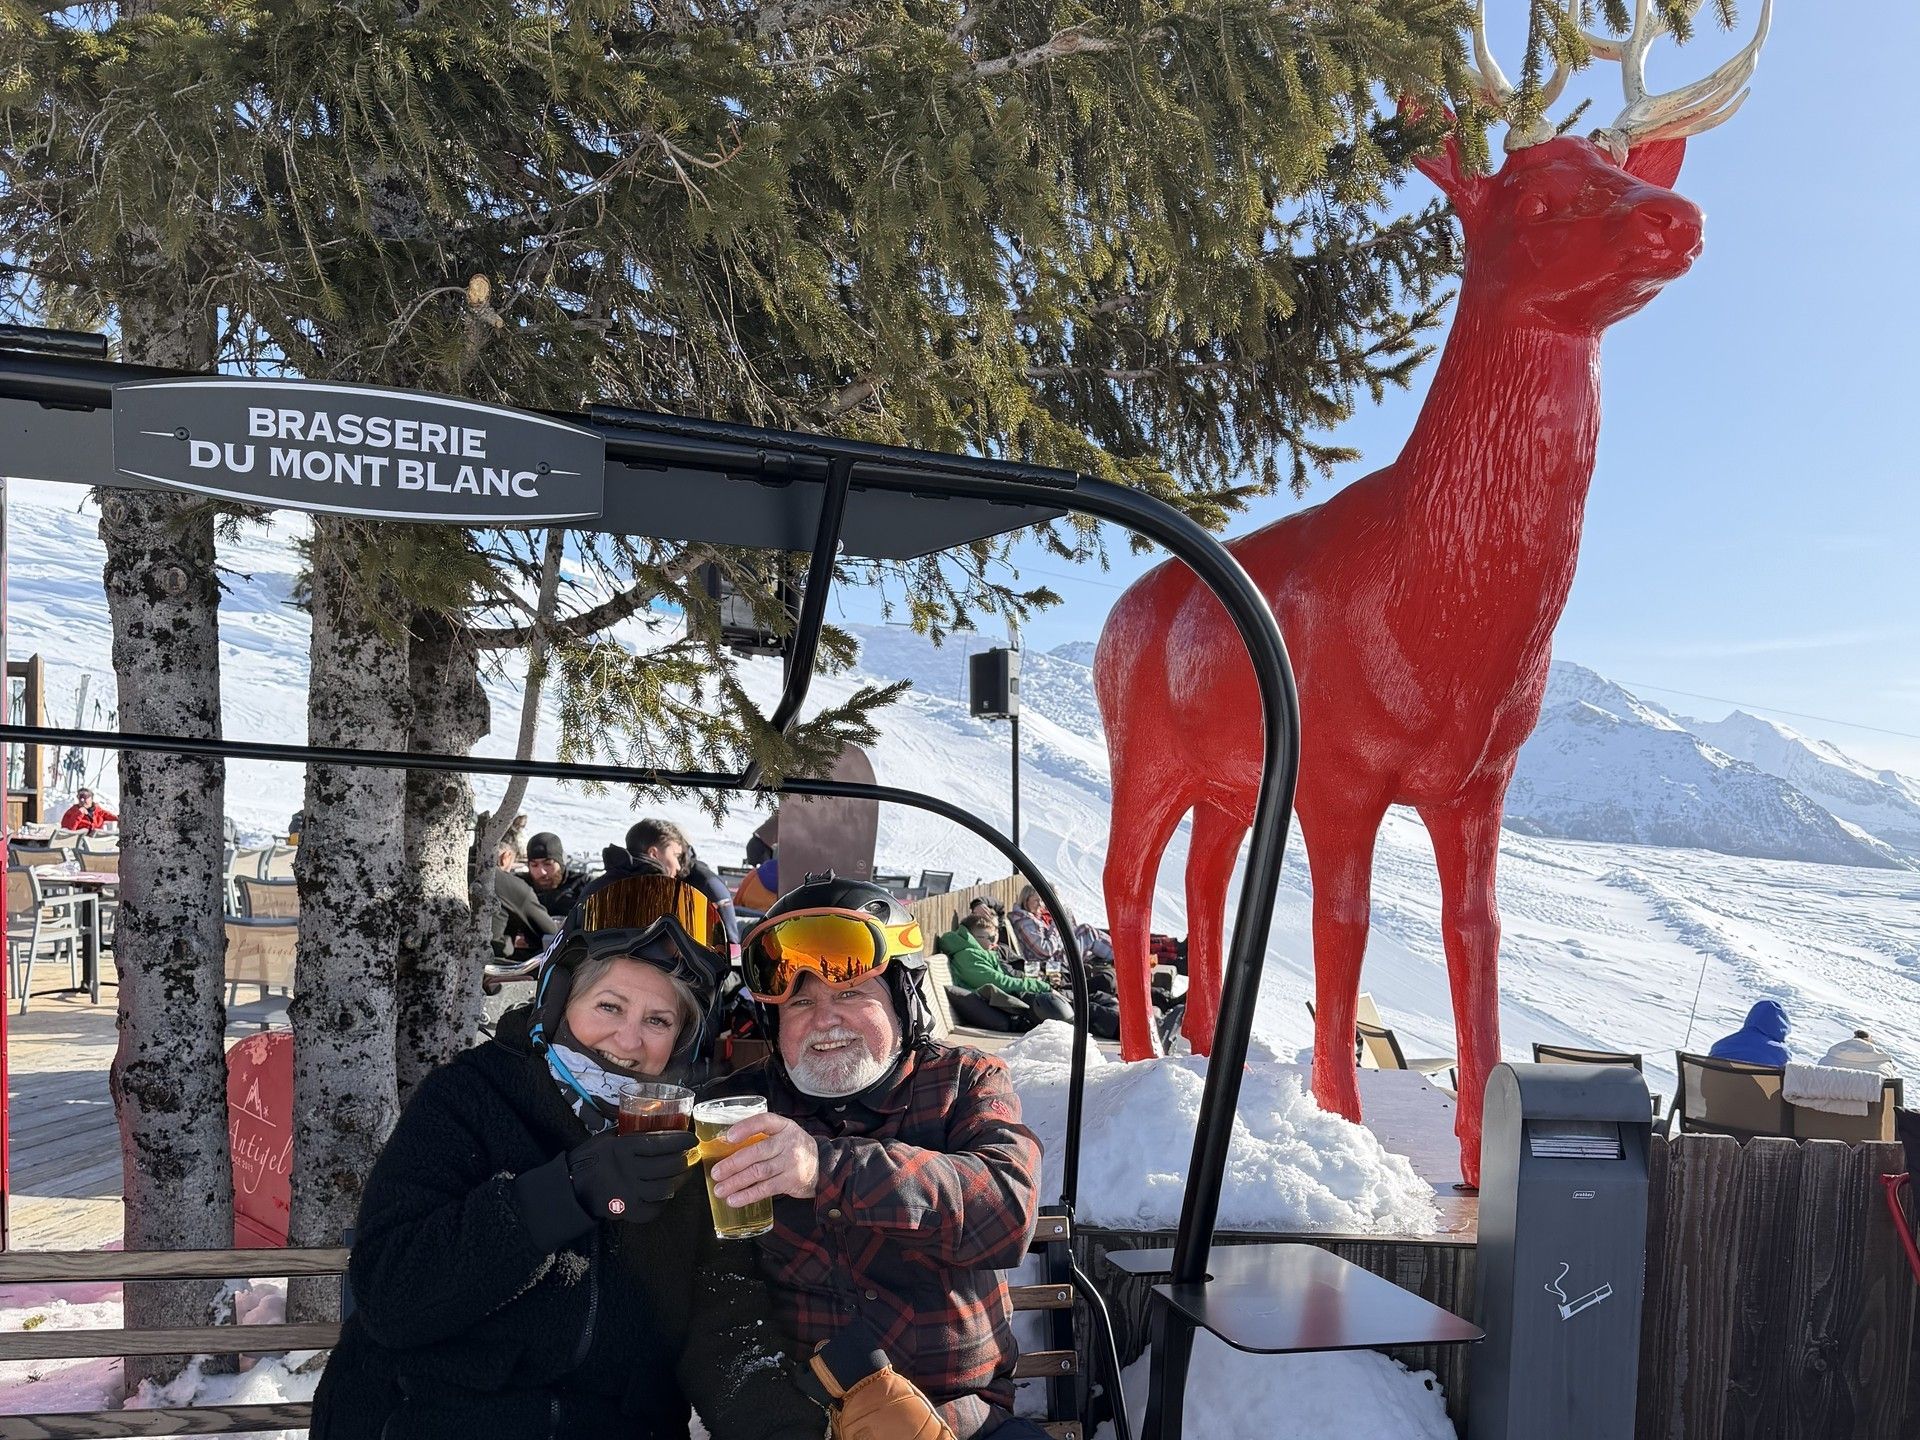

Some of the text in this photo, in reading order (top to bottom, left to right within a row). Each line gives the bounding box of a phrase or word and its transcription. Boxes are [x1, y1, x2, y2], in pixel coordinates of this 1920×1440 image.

[247, 407, 487, 460] BRASSERIE
[189, 439, 539, 499] DU MONT BLANC
